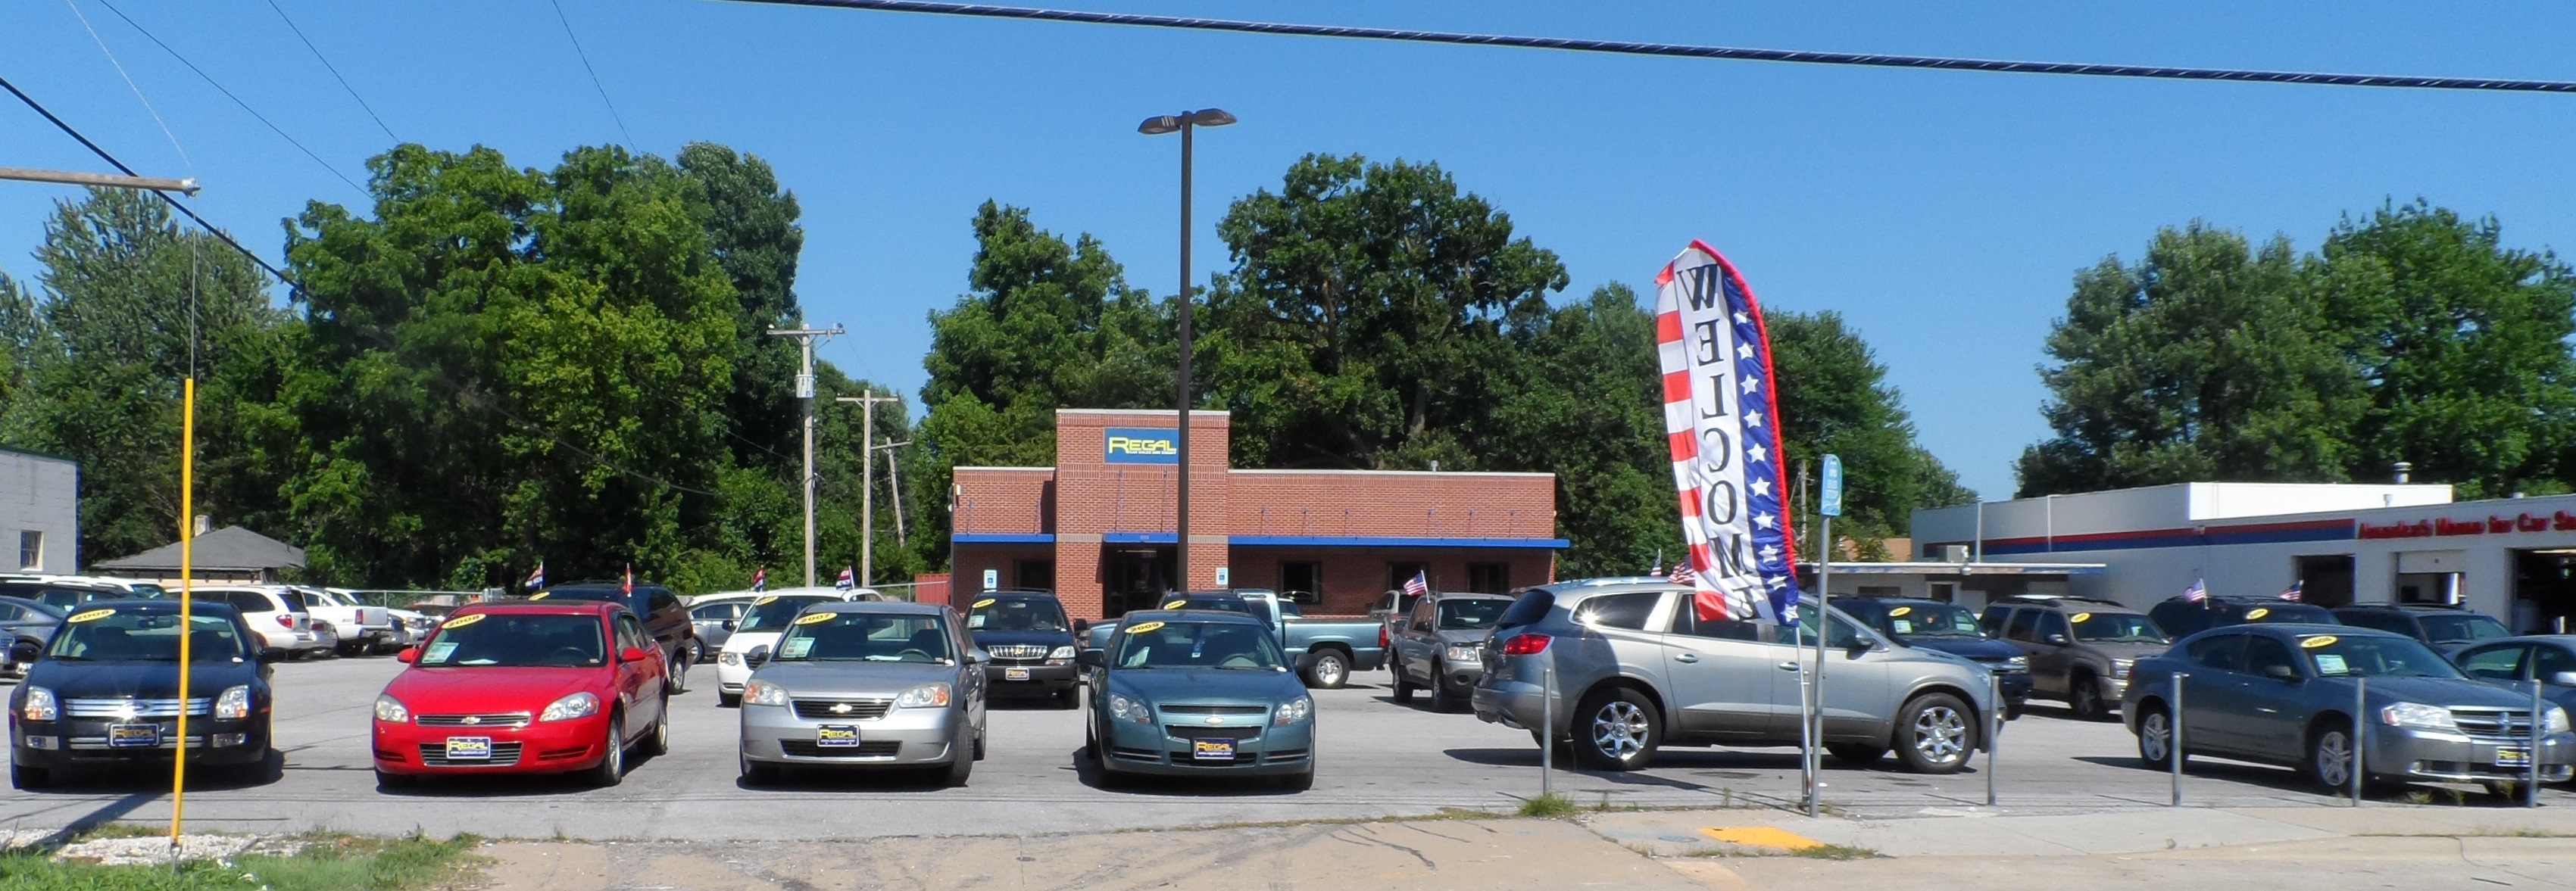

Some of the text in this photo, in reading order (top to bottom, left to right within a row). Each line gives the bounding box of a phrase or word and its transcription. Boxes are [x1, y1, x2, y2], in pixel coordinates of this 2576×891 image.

[1109, 437, 1177, 453] REGAL
[820, 729, 857, 739] REGAL
[449, 740, 488, 751] REGAL
